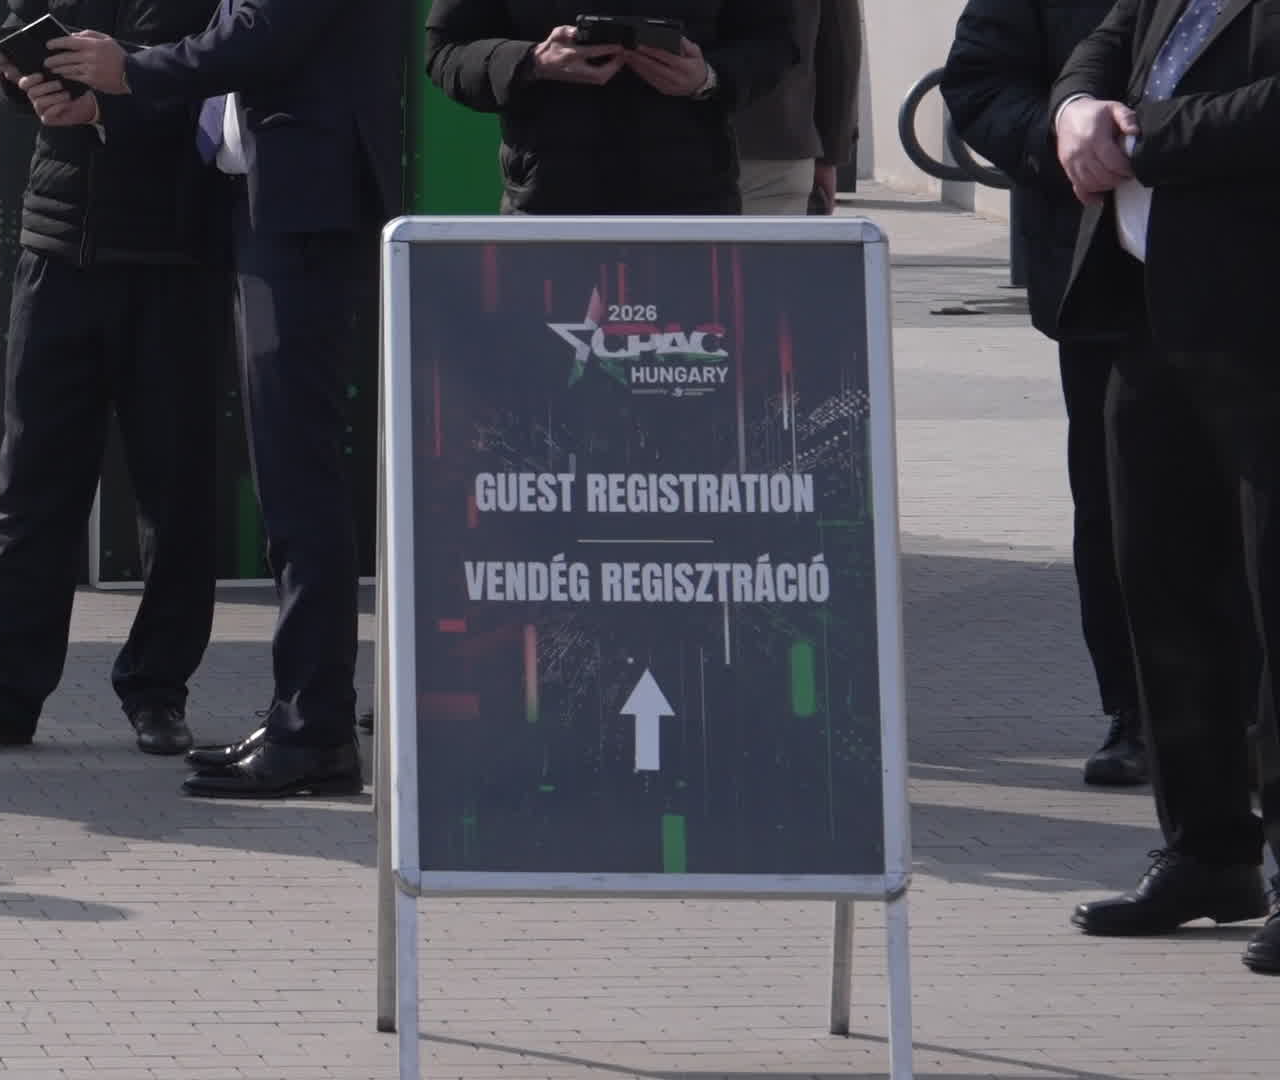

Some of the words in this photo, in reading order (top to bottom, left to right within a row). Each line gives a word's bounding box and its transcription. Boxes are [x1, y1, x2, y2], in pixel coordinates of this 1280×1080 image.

[608, 305, 657, 321] 2026
[591, 322, 728, 361] CPAC
[631, 367, 728, 384] HUNGARY
[475, 473, 576, 513] GUEST
[587, 473, 815, 513] REGISTRATION
[464, 553, 590, 602] VENDÉG
[601, 553, 830, 602] REGISZTRÁCIÓ
